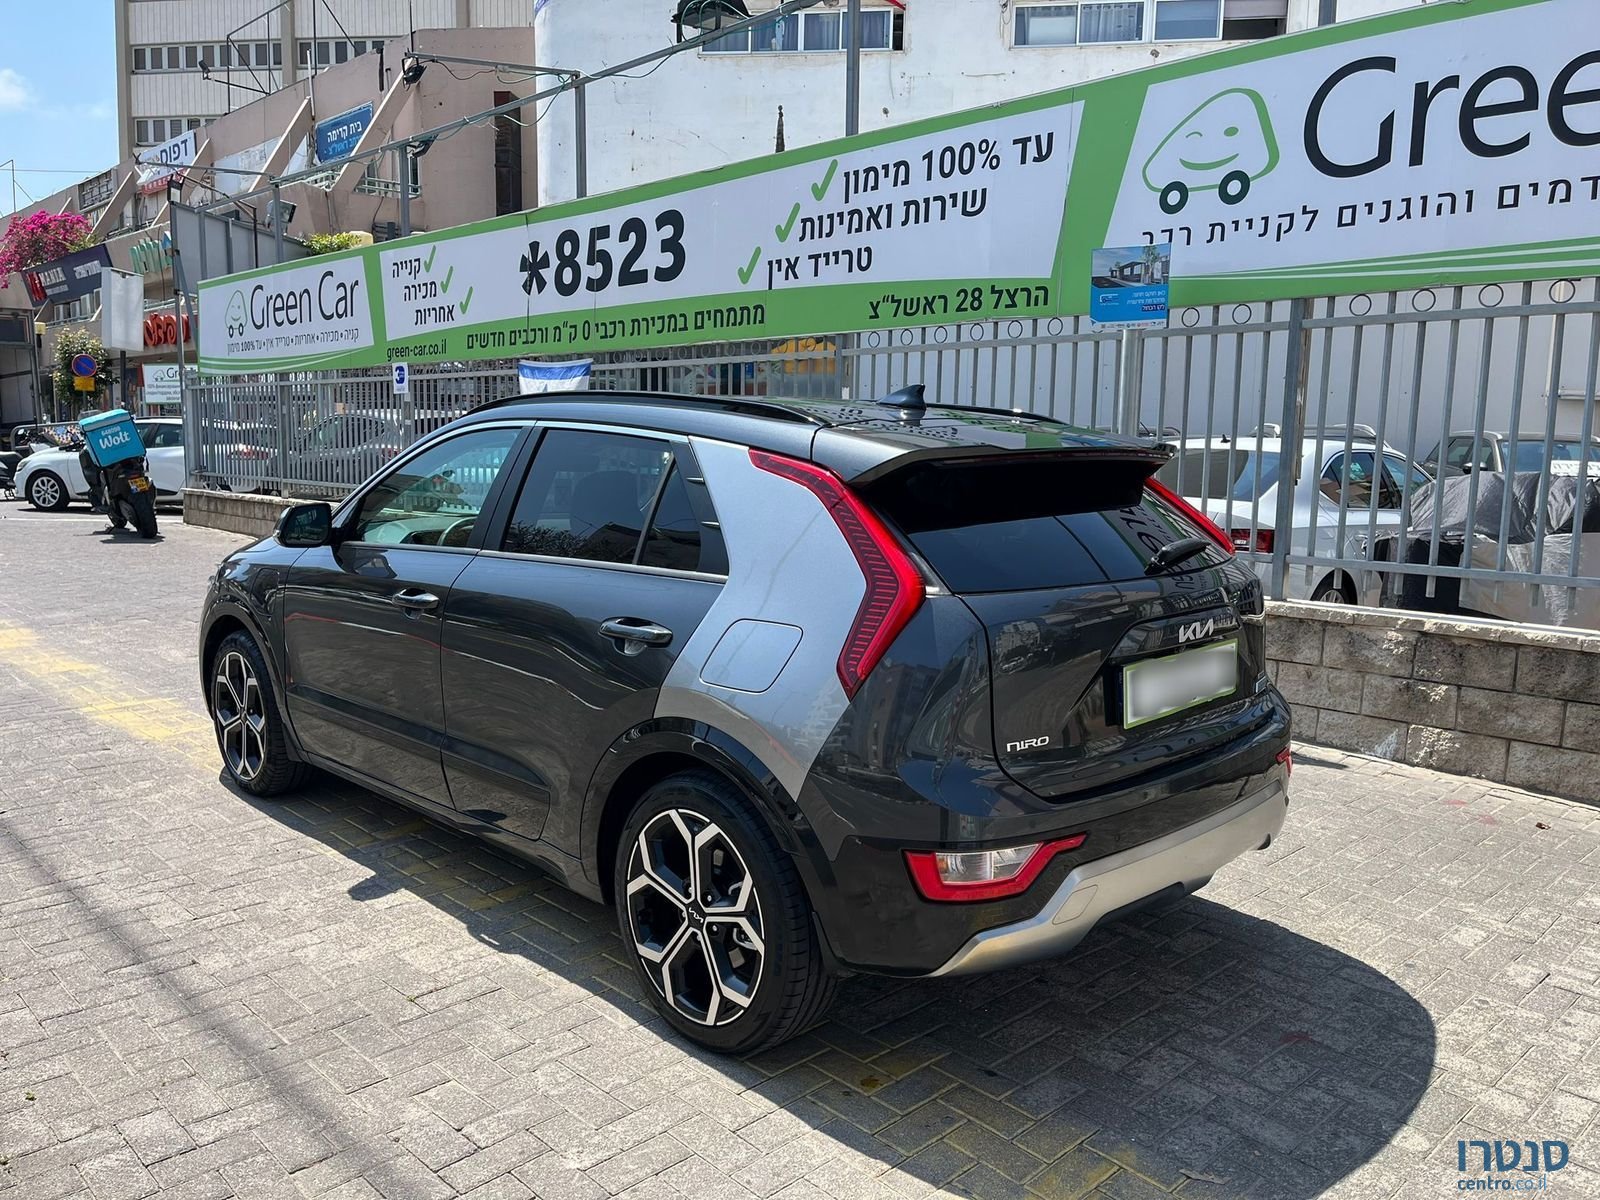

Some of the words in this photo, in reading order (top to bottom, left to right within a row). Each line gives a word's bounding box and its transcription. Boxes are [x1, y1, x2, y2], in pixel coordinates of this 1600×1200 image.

[327, 125, 348, 143] קדימה
[349, 120, 363, 135] בית
[160, 138, 188, 166] דפוס
[922, 138, 1001, 182] 100%
[1012, 131, 1054, 165] עד
[843, 159, 911, 204] מימון
[901, 187, 987, 226] שירות
[1337, 189, 1474, 228] והוגנים
[798, 203, 893, 242] ואמינות
[1206, 204, 1319, 244] לקניית
[392, 257, 421, 280] קנייה
[767, 256, 800, 290] אין
[807, 246, 873, 277] טרייד
[250, 284, 312, 330] Green
[318, 270, 359, 321] Car
[404, 280, 437, 302] מכירה
[955, 287, 983, 313] 28
[990, 284, 1049, 310] הרצל
[414, 304, 455, 326] אחריות
[629, 313, 689, 337] במכירת
[694, 304, 765, 330] מתמחים
[466, 331, 505, 350] חדשים
[509, 326, 549, 346] ורכבים
[582, 319, 591, 341] 0
[594, 319, 626, 340] רכבי
[241, 340, 256, 352] 100%
[386, 338, 447, 362] green-car.co.il
[99, 431, 131, 449] Wolt
[1178, 618, 1214, 643] KIA
[1006, 735, 1050, 752] NIRO
